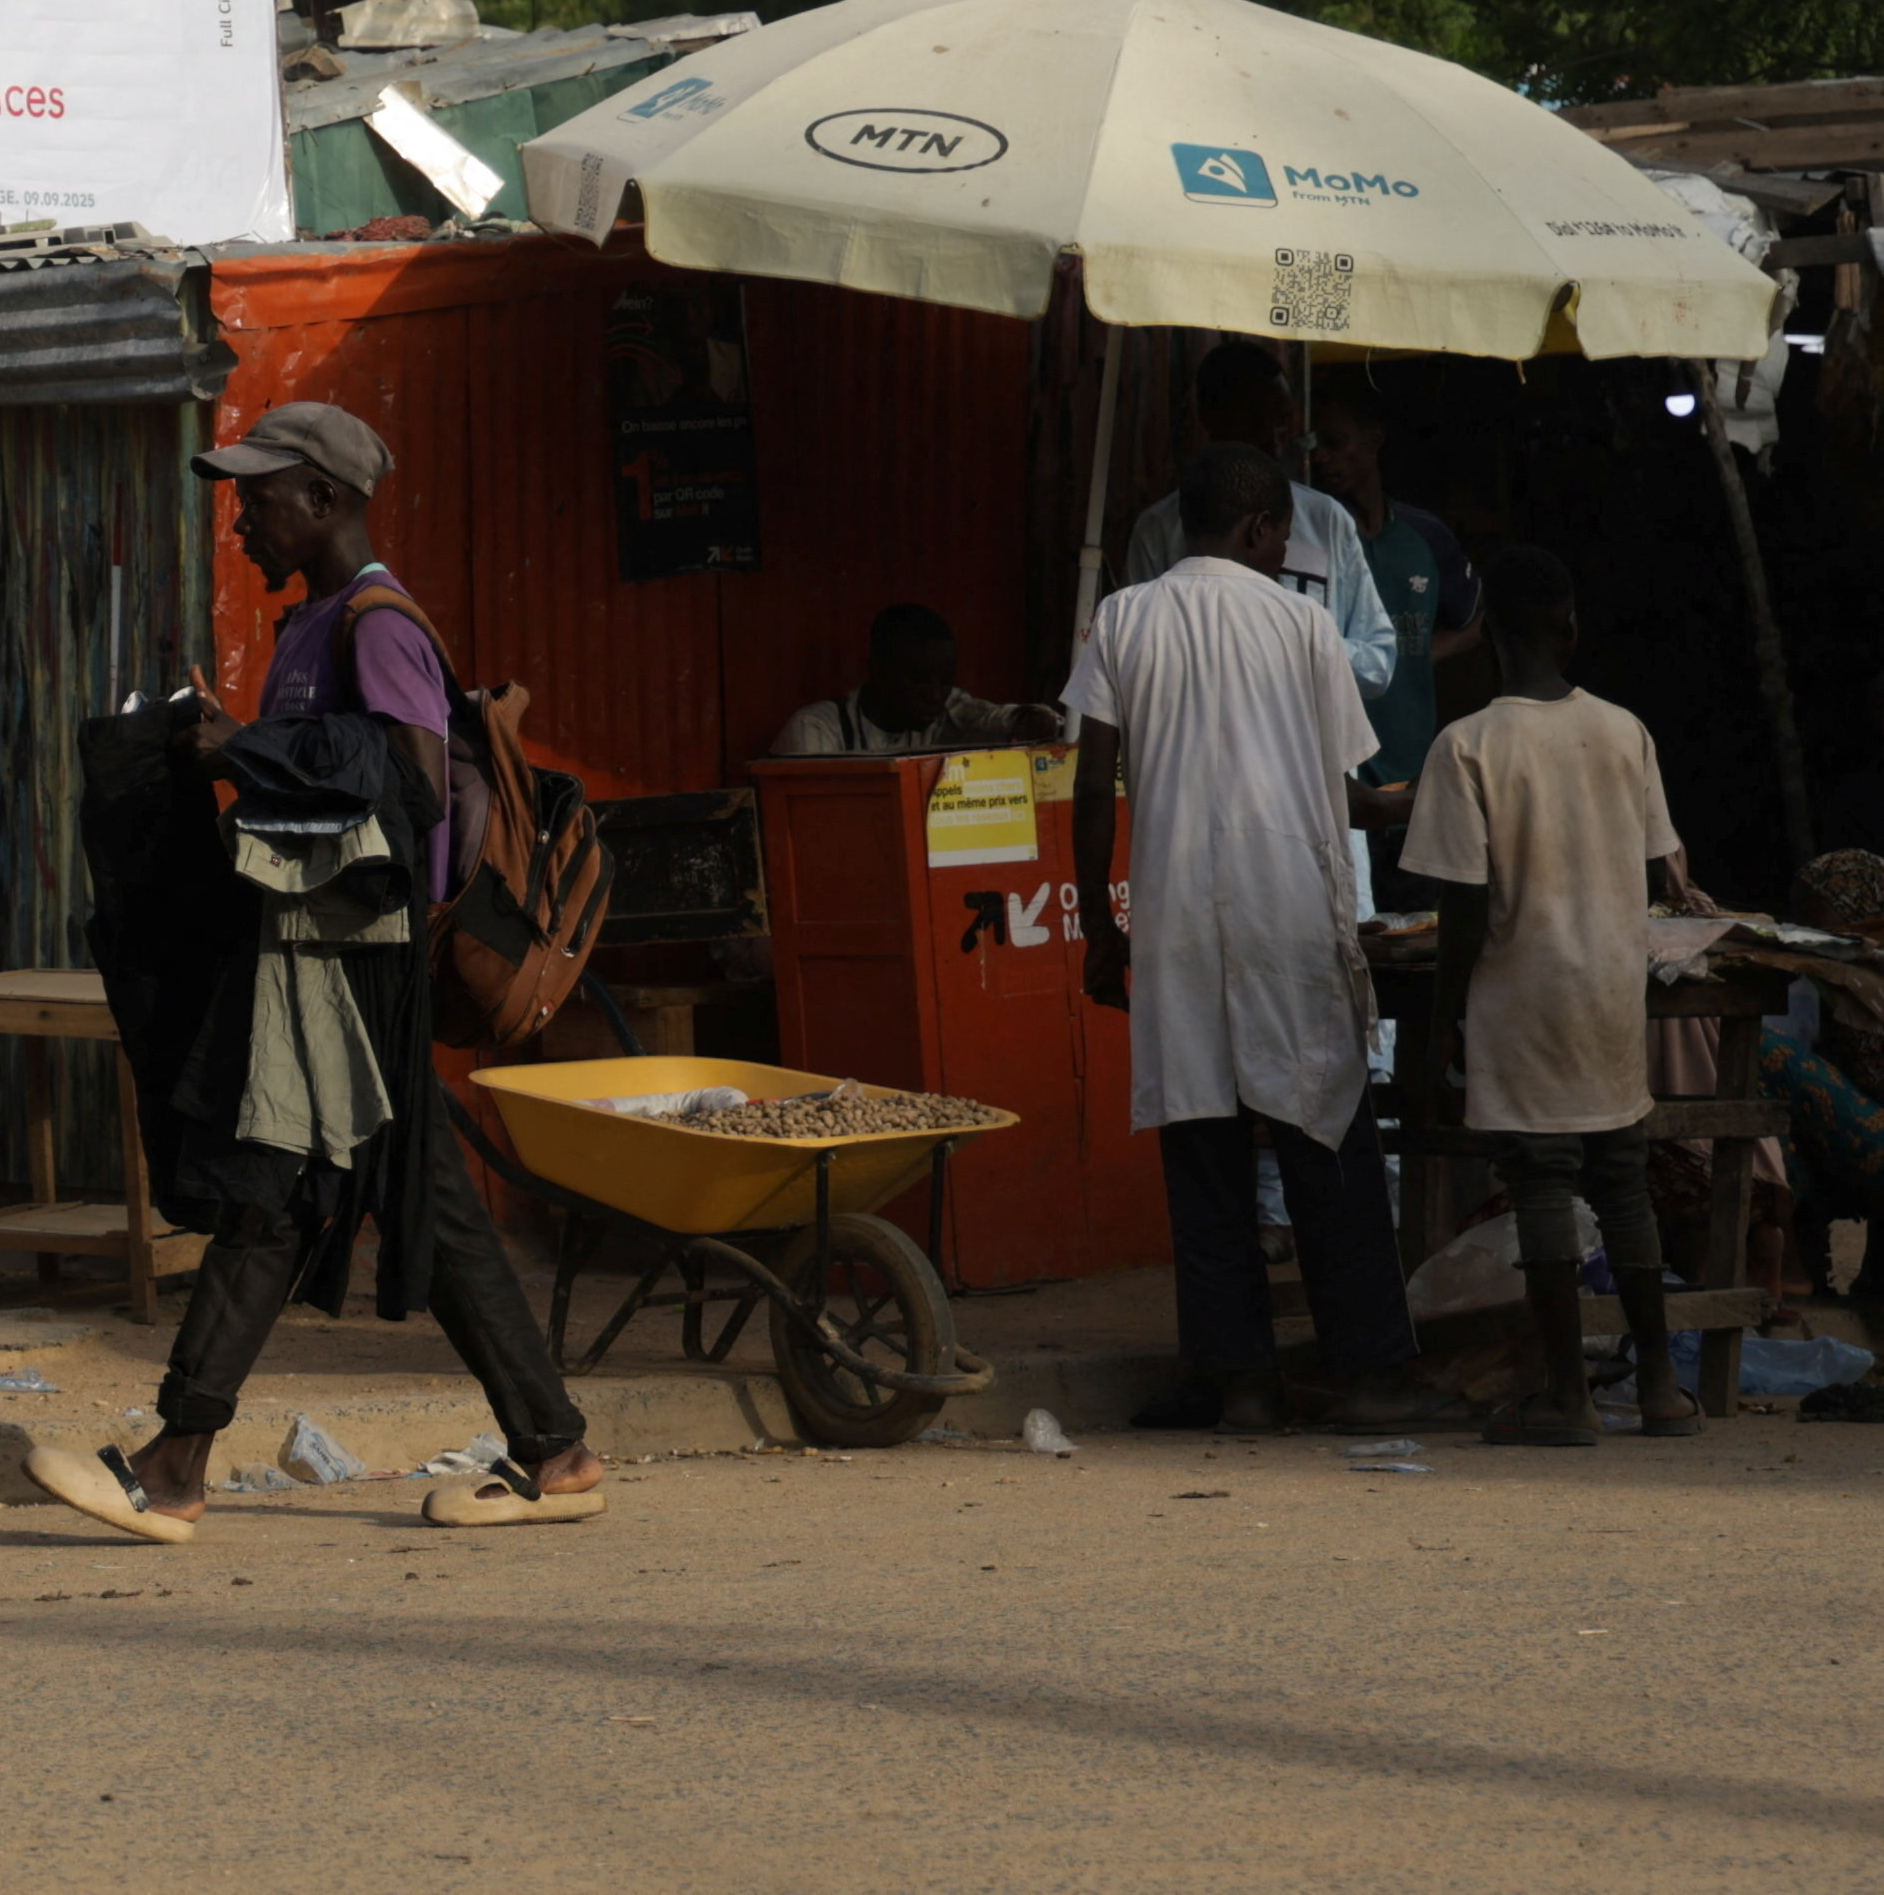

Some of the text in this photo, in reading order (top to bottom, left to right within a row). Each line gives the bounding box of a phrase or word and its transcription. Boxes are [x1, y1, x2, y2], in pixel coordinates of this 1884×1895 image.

[220, 20, 233, 48] Full
[850, 124, 963, 157] MTN
[1283, 165, 1419, 198] MoMo
[24, 192, 96, 208] 09.09.2025
[1292, 190, 1371, 206] from MTN
[674, 486, 695, 502] QR
[930, 794, 1028, 811] et au même prix vers
